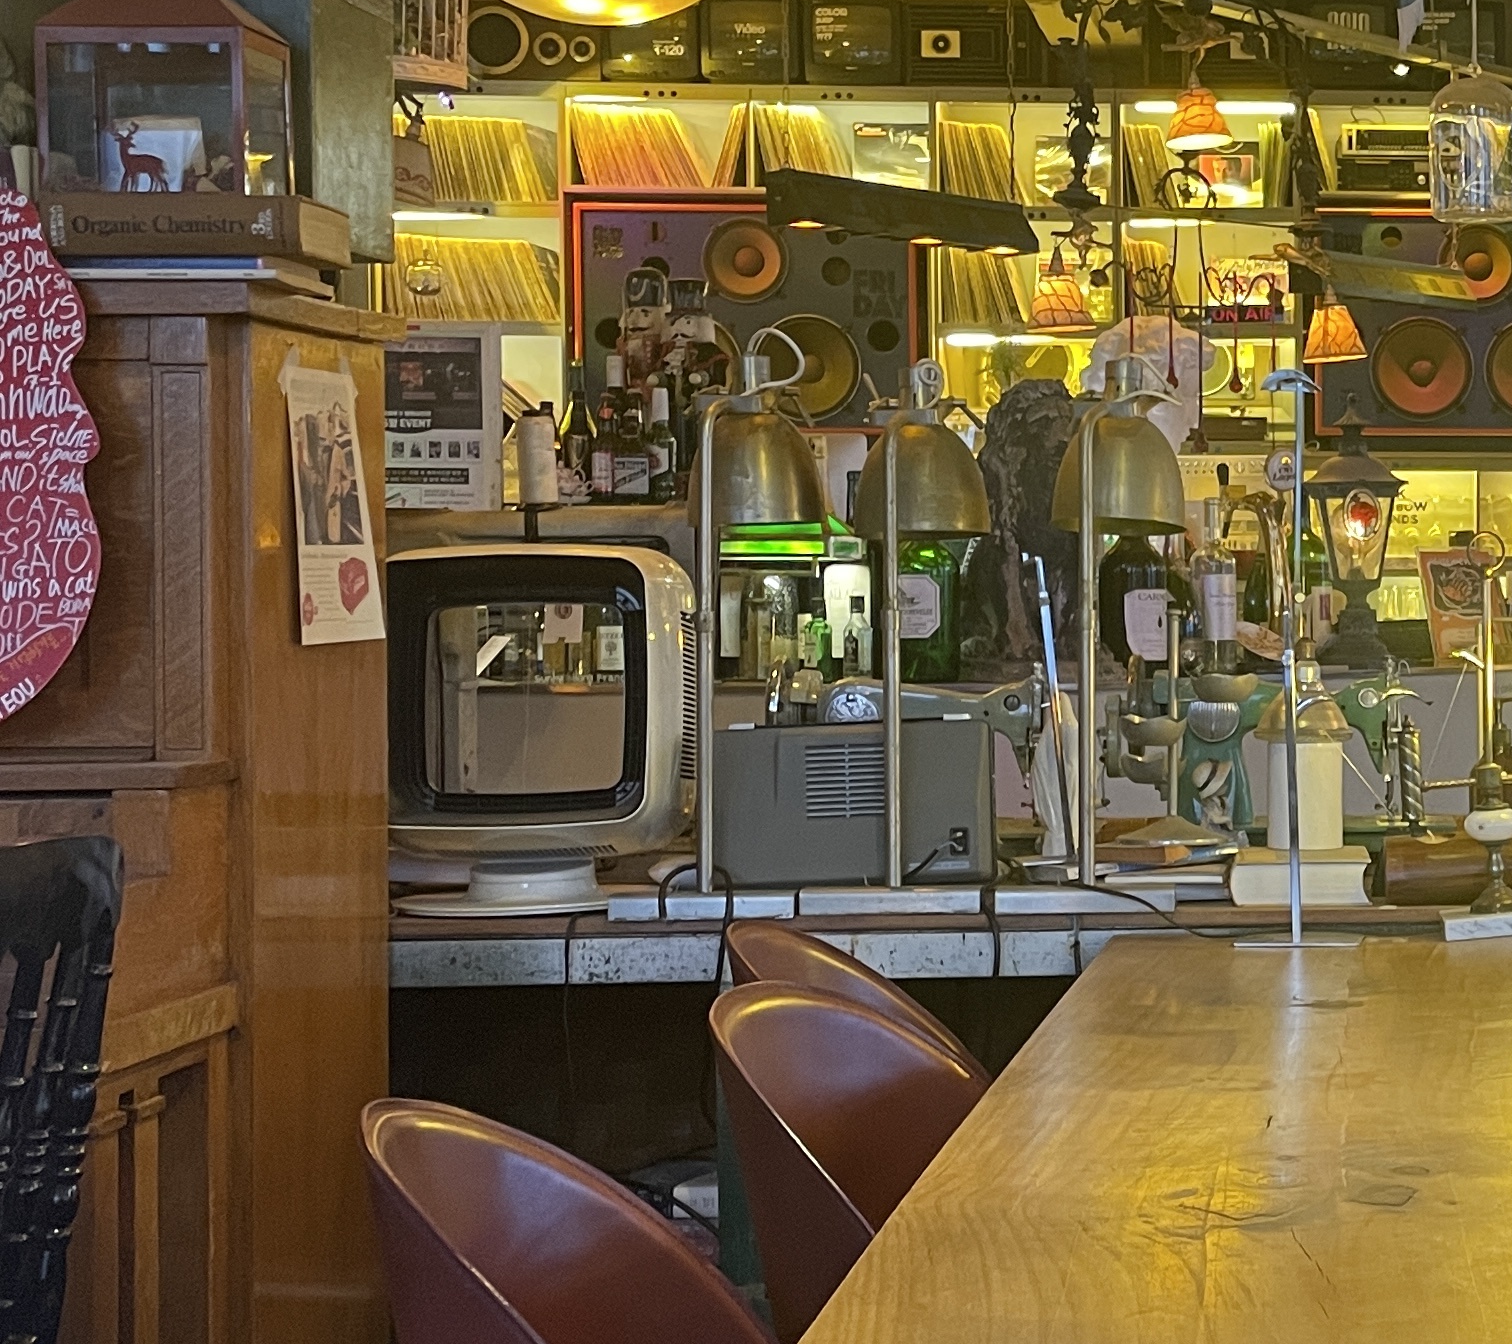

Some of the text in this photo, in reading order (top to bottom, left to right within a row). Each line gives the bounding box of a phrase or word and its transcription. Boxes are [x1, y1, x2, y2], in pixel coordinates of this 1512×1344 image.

[72, 214, 147, 237] Organic
[152, 213, 246, 234] Chemistry
[1211, 308, 1238, 322] ON
